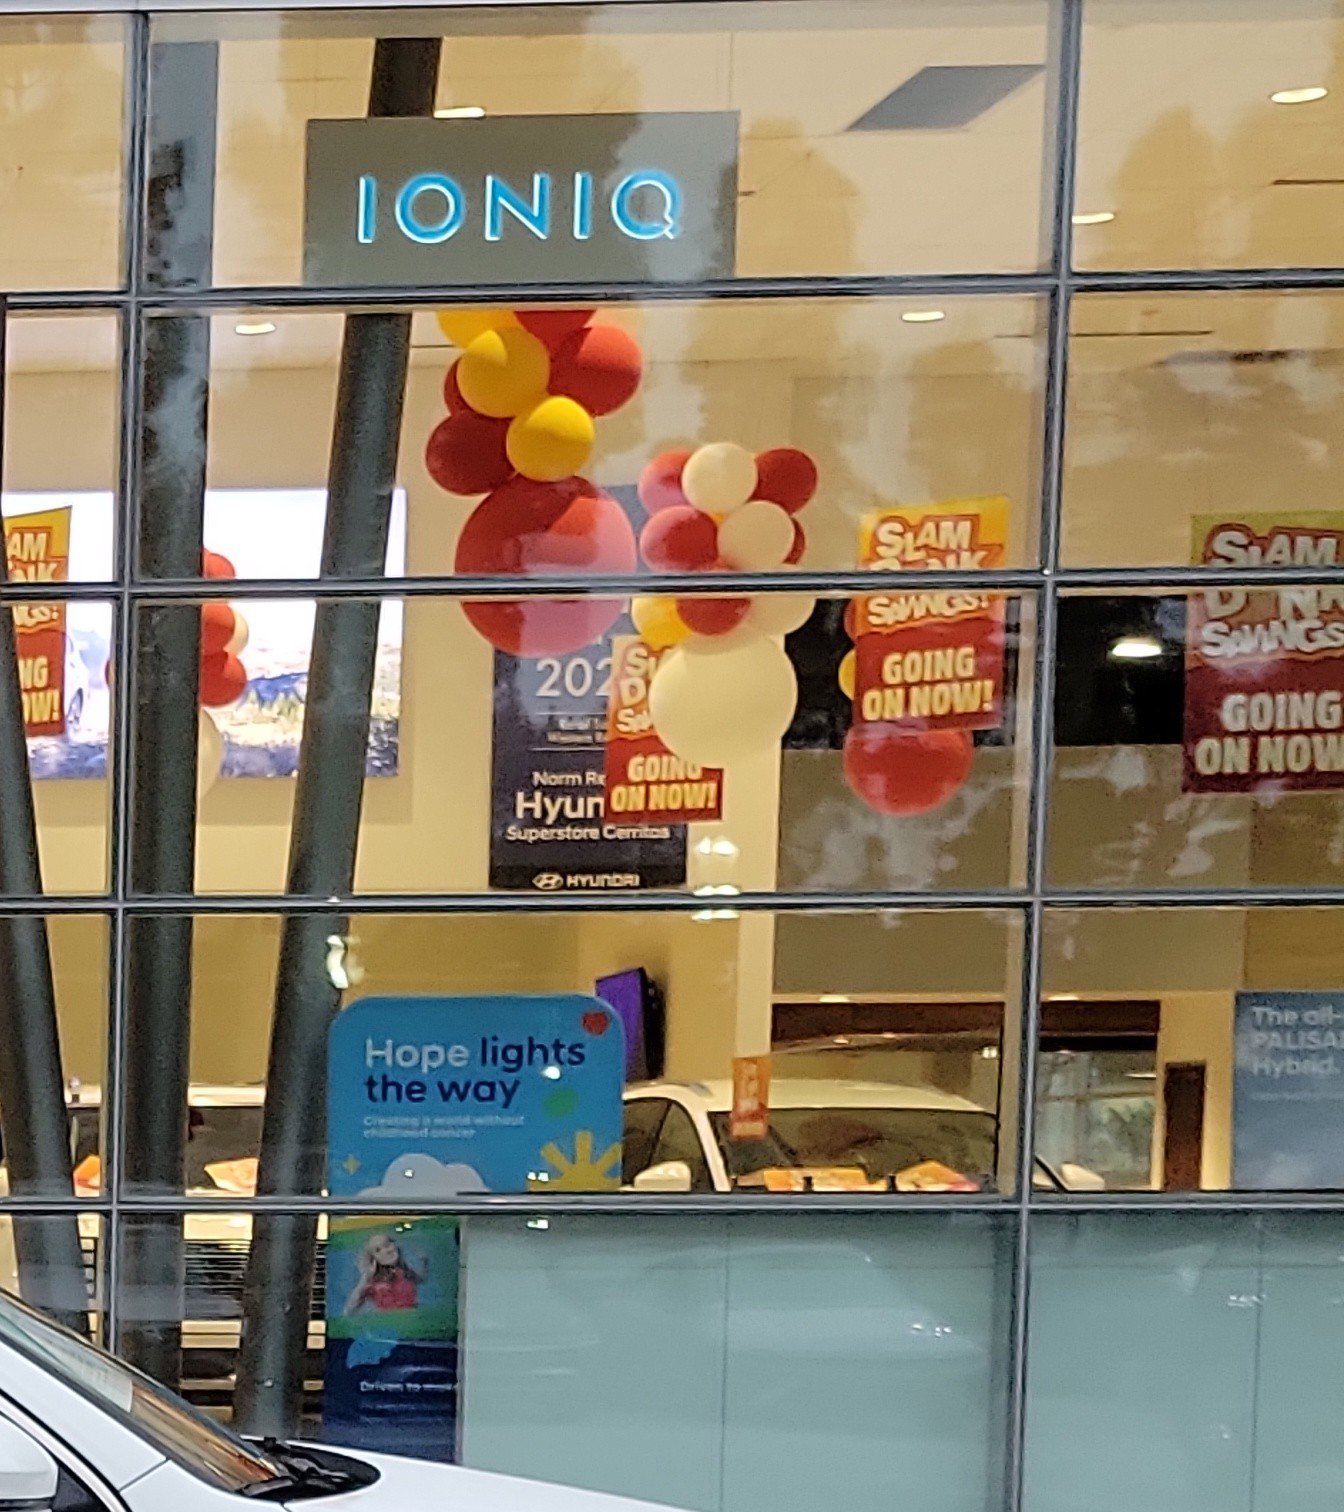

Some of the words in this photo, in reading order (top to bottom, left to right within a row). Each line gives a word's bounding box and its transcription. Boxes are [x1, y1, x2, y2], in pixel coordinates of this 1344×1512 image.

[357, 170, 682, 243] IONIQ
[876, 522, 972, 561] SLAM
[536, 657, 611, 697] 202
[883, 647, 974, 684] GOING
[862, 689, 905, 720] ON
[910, 681, 995, 717] NOW!
[1222, 692, 1342, 732] GOING
[1195, 737, 1250, 775] ON
[533, 772, 582, 787] Norm
[612, 786, 645, 812] ON
[649, 783, 718, 810] NOW!
[516, 791, 605, 824] Hyun
[506, 826, 599, 843] Superstore
[566, 873, 640, 887] HYUNDAI
[365, 1038, 469, 1073] Hope
[481, 1036, 586, 1072] lights
[1252, 1030, 1344, 1050] PALISA
[364, 1074, 427, 1103] the
[437, 1079, 521, 1109] way
